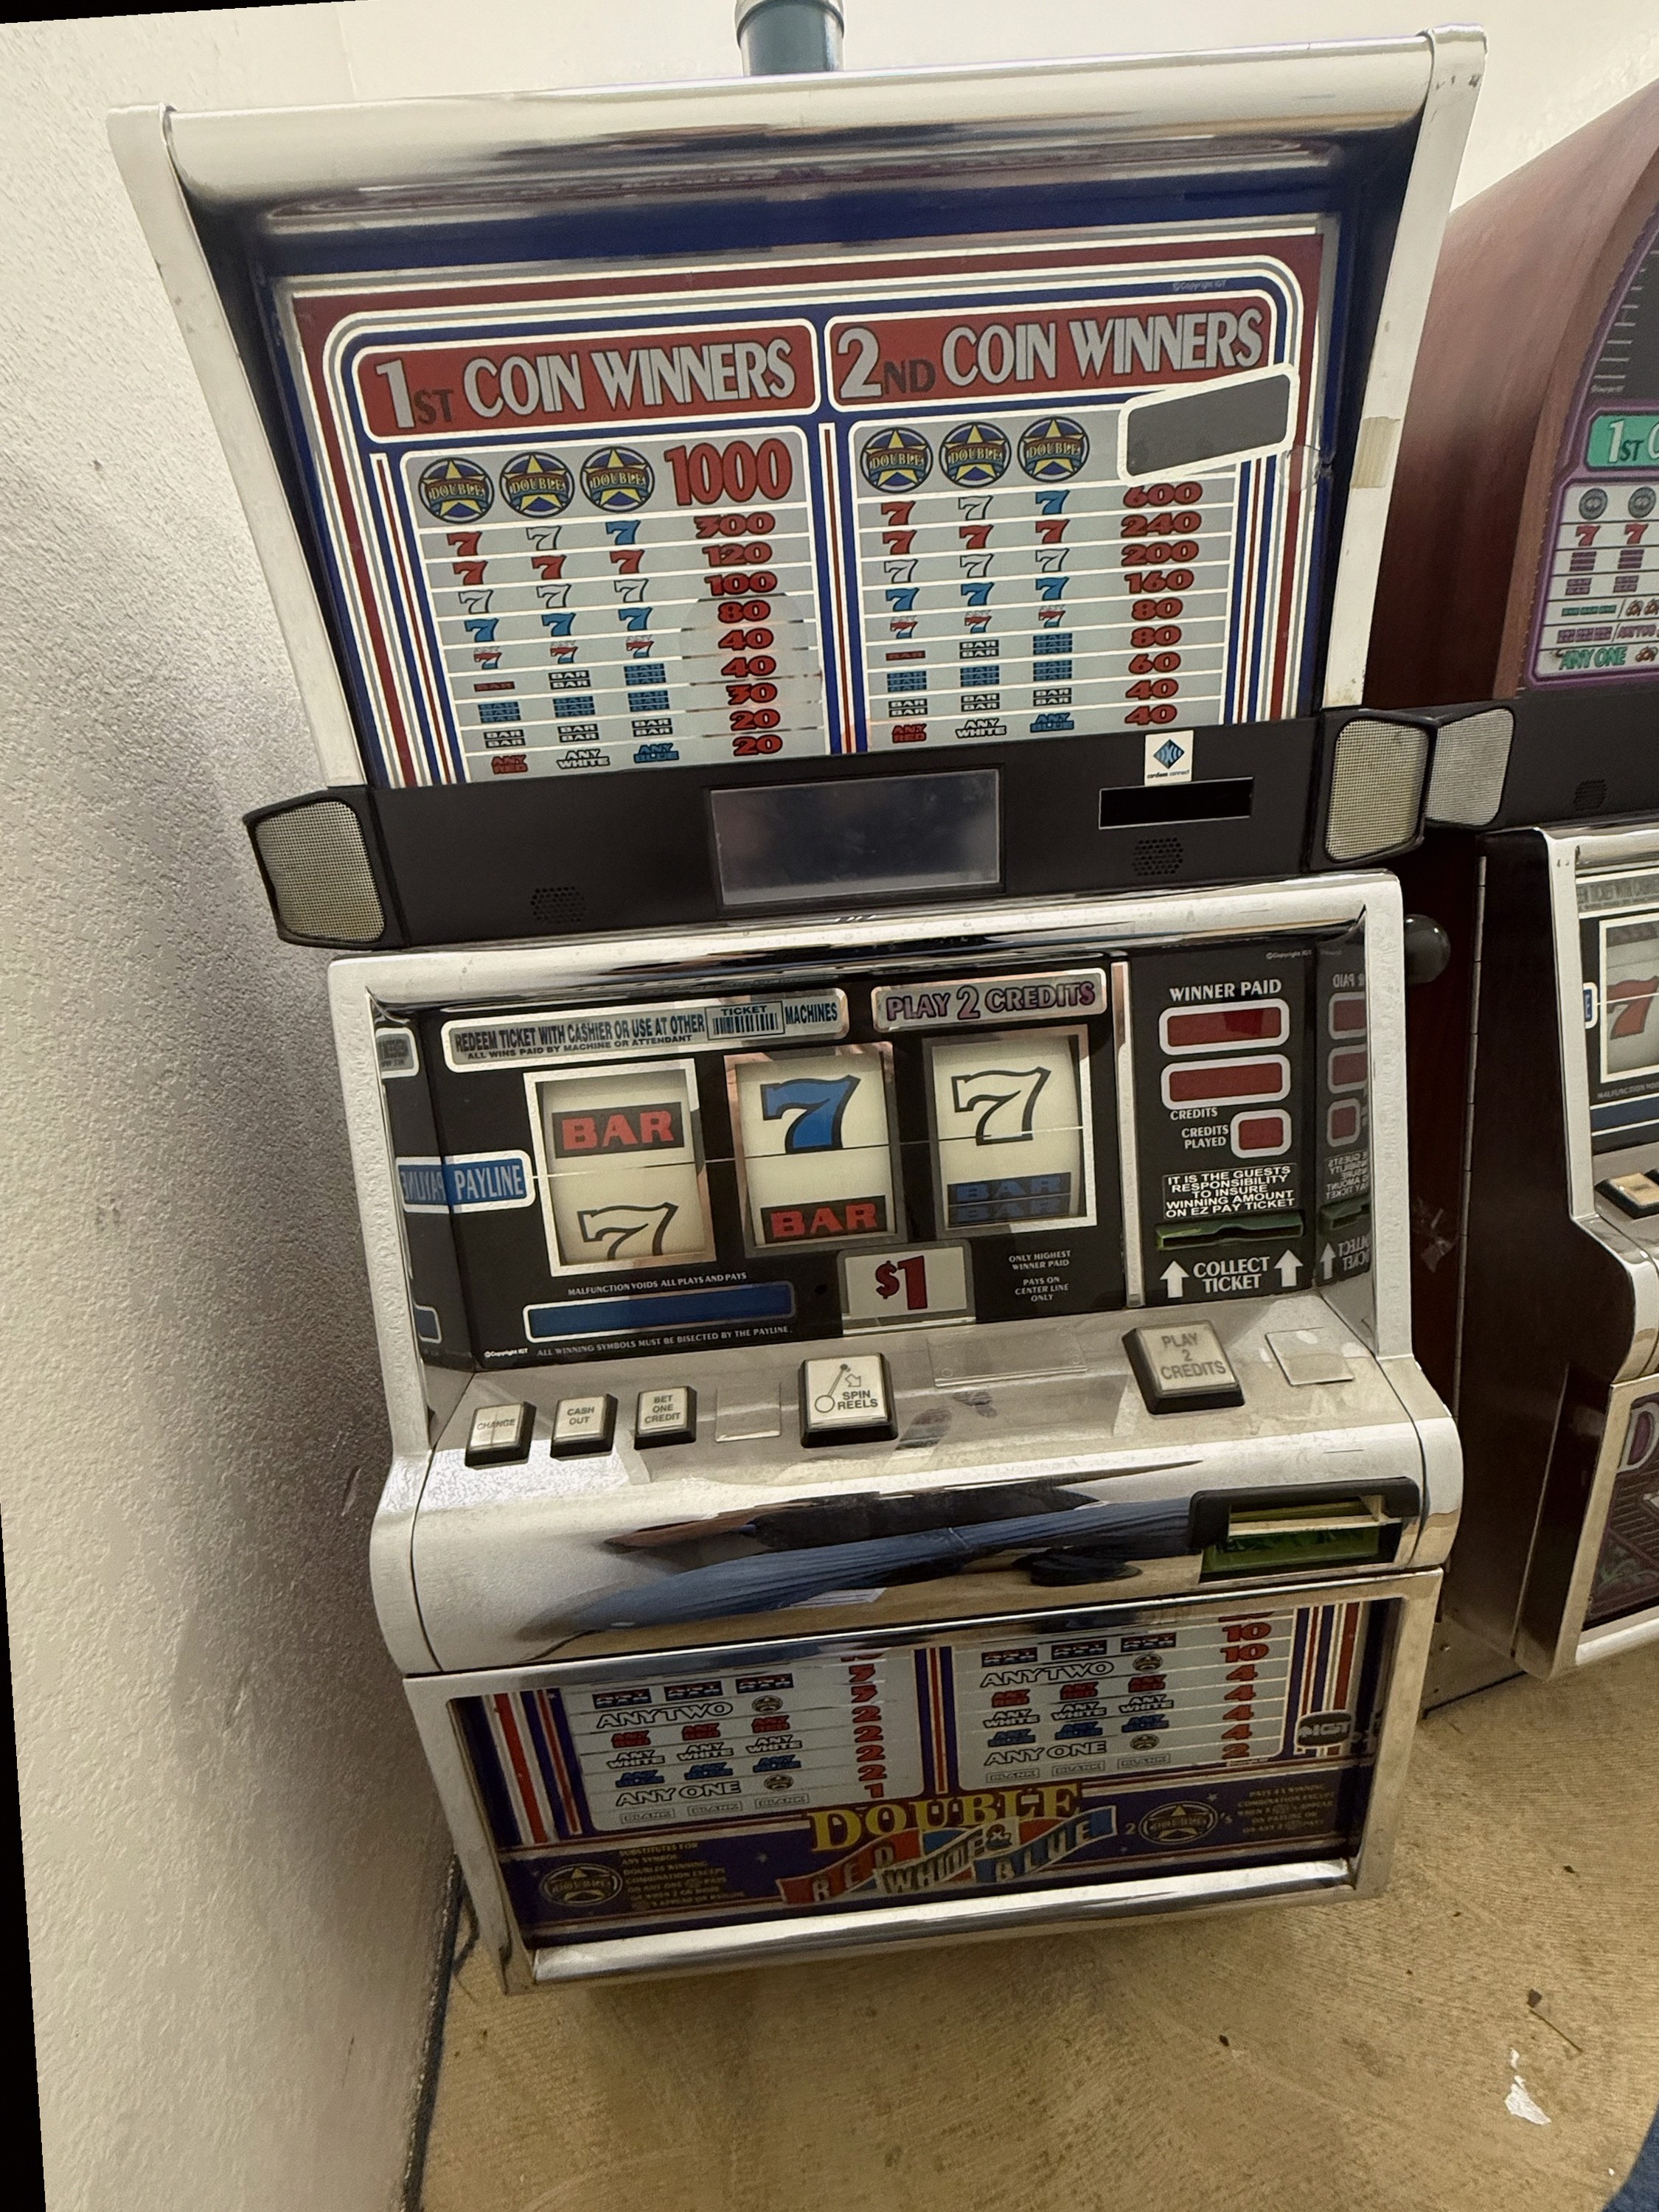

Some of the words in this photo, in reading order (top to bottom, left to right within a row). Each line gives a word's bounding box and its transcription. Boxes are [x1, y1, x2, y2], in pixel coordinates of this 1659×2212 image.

[942, 321, 1056, 386] COIN
[1069, 307, 1262, 378] WINNERS
[463, 353, 585, 418] COIN
[591, 338, 796, 411] WINNERS
[871, 451, 922, 470] DOUBLE
[949, 446, 1002, 464] DOUBLE
[1026, 441, 1080, 459] DOUBLE
[591, 467, 646, 488] DOUBLE
[664, 438, 793, 506] 1000
[428, 479, 485, 499] DOUBLE
[511, 473, 566, 494] DOUBLE
[1122, 481, 1203, 508] 600
[693, 512, 776, 539] 300
[1121, 510, 1202, 538] 240
[701, 541, 773, 567] 120
[1121, 540, 1199, 567] 200
[705, 570, 777, 597] 100
[1124, 568, 1194, 594] 160
[717, 599, 771, 623] 80
[1131, 597, 1183, 621] 80
[717, 627, 774, 651] 40
[1130, 625, 1182, 647] 80
[721, 655, 776, 678] 40
[1128, 651, 1182, 674] 60
[1593, 646, 1628, 668] ONE
[726, 682, 778, 705] 30
[1126, 678, 1179, 700] 40
[730, 708, 781, 731] 20
[1124, 704, 1178, 726] 40
[733, 734, 783, 757] 20
[1169, 982, 1236, 1002] WINNER
[1240, 978, 1281, 995] PAID
[886, 992, 950, 1021] PLAY
[957, 985, 981, 1020] 2
[985, 981, 1096, 1013] CREDITS
[455, 1030, 498, 1052] REDEEM
[499, 1027, 536, 1048] TICKET
[538, 1025, 566, 1045] WITH
[568, 1020, 613, 1043] CASHIER
[614, 1019, 630, 1039] OR
[632, 1017, 653, 1037] USE
[655, 1016, 667, 1035] AT
[670, 1014, 705, 1034] OTHER
[721, 1005, 768, 1016] TICKET
[785, 1003, 838, 1024] MACHINES
[467, 1051, 487, 1060] ALL
[489, 1049, 516, 1058] WINS
[520, 1048, 544, 1056] PAID
[564, 1041, 611, 1051] MACHINE
[614, 1040, 630, 1048] OR
[632, 1034, 692, 1046] ATTENDANT
[760, 1074, 860, 1152] 7
[950, 1066, 1051, 1146] 7
[1169, 1107, 1218, 1121] CREDITS
[561, 1110, 674, 1150] BAR
[1181, 1124, 1229, 1138] CREDITS
[1184, 1136, 1227, 1150] PLAYED
[455, 1164, 524, 1200] PAYLINE
[1168, 1176, 1180, 1186] IT
[1184, 1175, 1197, 1183] IS
[1201, 1172, 1229, 1182] THE
[1234, 1166, 1291, 1179] GUESTS
[1172, 1174, 1288, 1193] RESPONSIBILITY
[961, 1174, 1062, 1201] BAR
[1192, 1190, 1211, 1199] TO
[1215, 1184, 1268, 1197] INSURE
[961, 1198, 1062, 1223] BAR
[1166, 1197, 1228, 1210] WINNING
[1232, 1190, 1294, 1203] AMOUNT
[1166, 1208, 1186, 1218] ON
[1191, 1207, 1208, 1216] EZ
[1212, 1203, 1241, 1214] PAY
[1245, 1198, 1295, 1210] TICKET
[770, 1203, 877, 1238] BAR
[1008, 1254, 1032, 1262] ONLY
[1034, 1250, 1071, 1260] HIGHEST
[1012, 1262, 1046, 1270] WINNER
[1048, 1259, 1070, 1267] PAID
[1193, 1256, 1270, 1278] COLLECT
[568, 1284, 630, 1295] MALFUNCTION
[661, 1279, 677, 1287] ALL
[678, 1276, 703, 1286] PLAYS
[705, 1274, 724, 1283] AND
[725, 1272, 747, 1281] PAYS
[874, 1255, 928, 1311] $1
[1015, 1285, 1048, 1295] CENTER
[1050, 1283, 1069, 1292] LINE
[1023, 1277, 1045, 1286] PAYS
[1202, 1274, 1262, 1293] TICKET
[1031, 1294, 1054, 1302] ONLY
[537, 1349, 552, 1357] ALL
[554, 1345, 594, 1355] WINNING
[597, 1340, 636, 1352] SYMBOLS
[639, 1339, 661, 1347] MUST
[663, 1337, 675, 1345] BE
[677, 1333, 719, 1343] BISECTED
[735, 1329, 751, 1338] THE
[1161, 1332, 1198, 1349] PLAY
[1181, 1349, 1192, 1361] 2
[1161, 1360, 1226, 1380] CREDITS
[653, 1394, 673, 1404] BET
[837, 1398, 878, 1411] REELS
[842, 1390, 871, 1400] SPIN
[567, 1406, 594, 1416] CASH
[644, 1412, 681, 1424] CREDIT
[652, 1404, 674, 1413] ONE
[476, 1419, 515, 1430] CHANGE
[568, 1416, 591, 1425] OUT
[1222, 1622, 1272, 1642] 10
[1220, 1643, 1269, 1663] 10
[1225, 1664, 1259, 1681] 4
[1224, 1684, 1256, 1701] 4
[852, 1705, 882, 1723] 2
[1222, 1704, 1254, 1720] 4
[853, 1725, 884, 1743] 2
[1221, 1723, 1253, 1740] 4
[1313, 1722, 1350, 1736] IGT
[855, 1745, 886, 1762] 2
[984, 1747, 1045, 1766] ANY
[1047, 1740, 1107, 1758] ONE
[1222, 1743, 1251, 1759] 2
[858, 1764, 887, 1781] 2
[616, 1788, 676, 1806] ANY
[678, 1781, 741, 1798] ONE
[864, 1783, 884, 1798] 1
[812, 1783, 1080, 1852] DOUBLE
[812, 1846, 894, 1902] RED
[885, 1836, 984, 1895] WHITE
[995, 1821, 1091, 1882] BLUE
